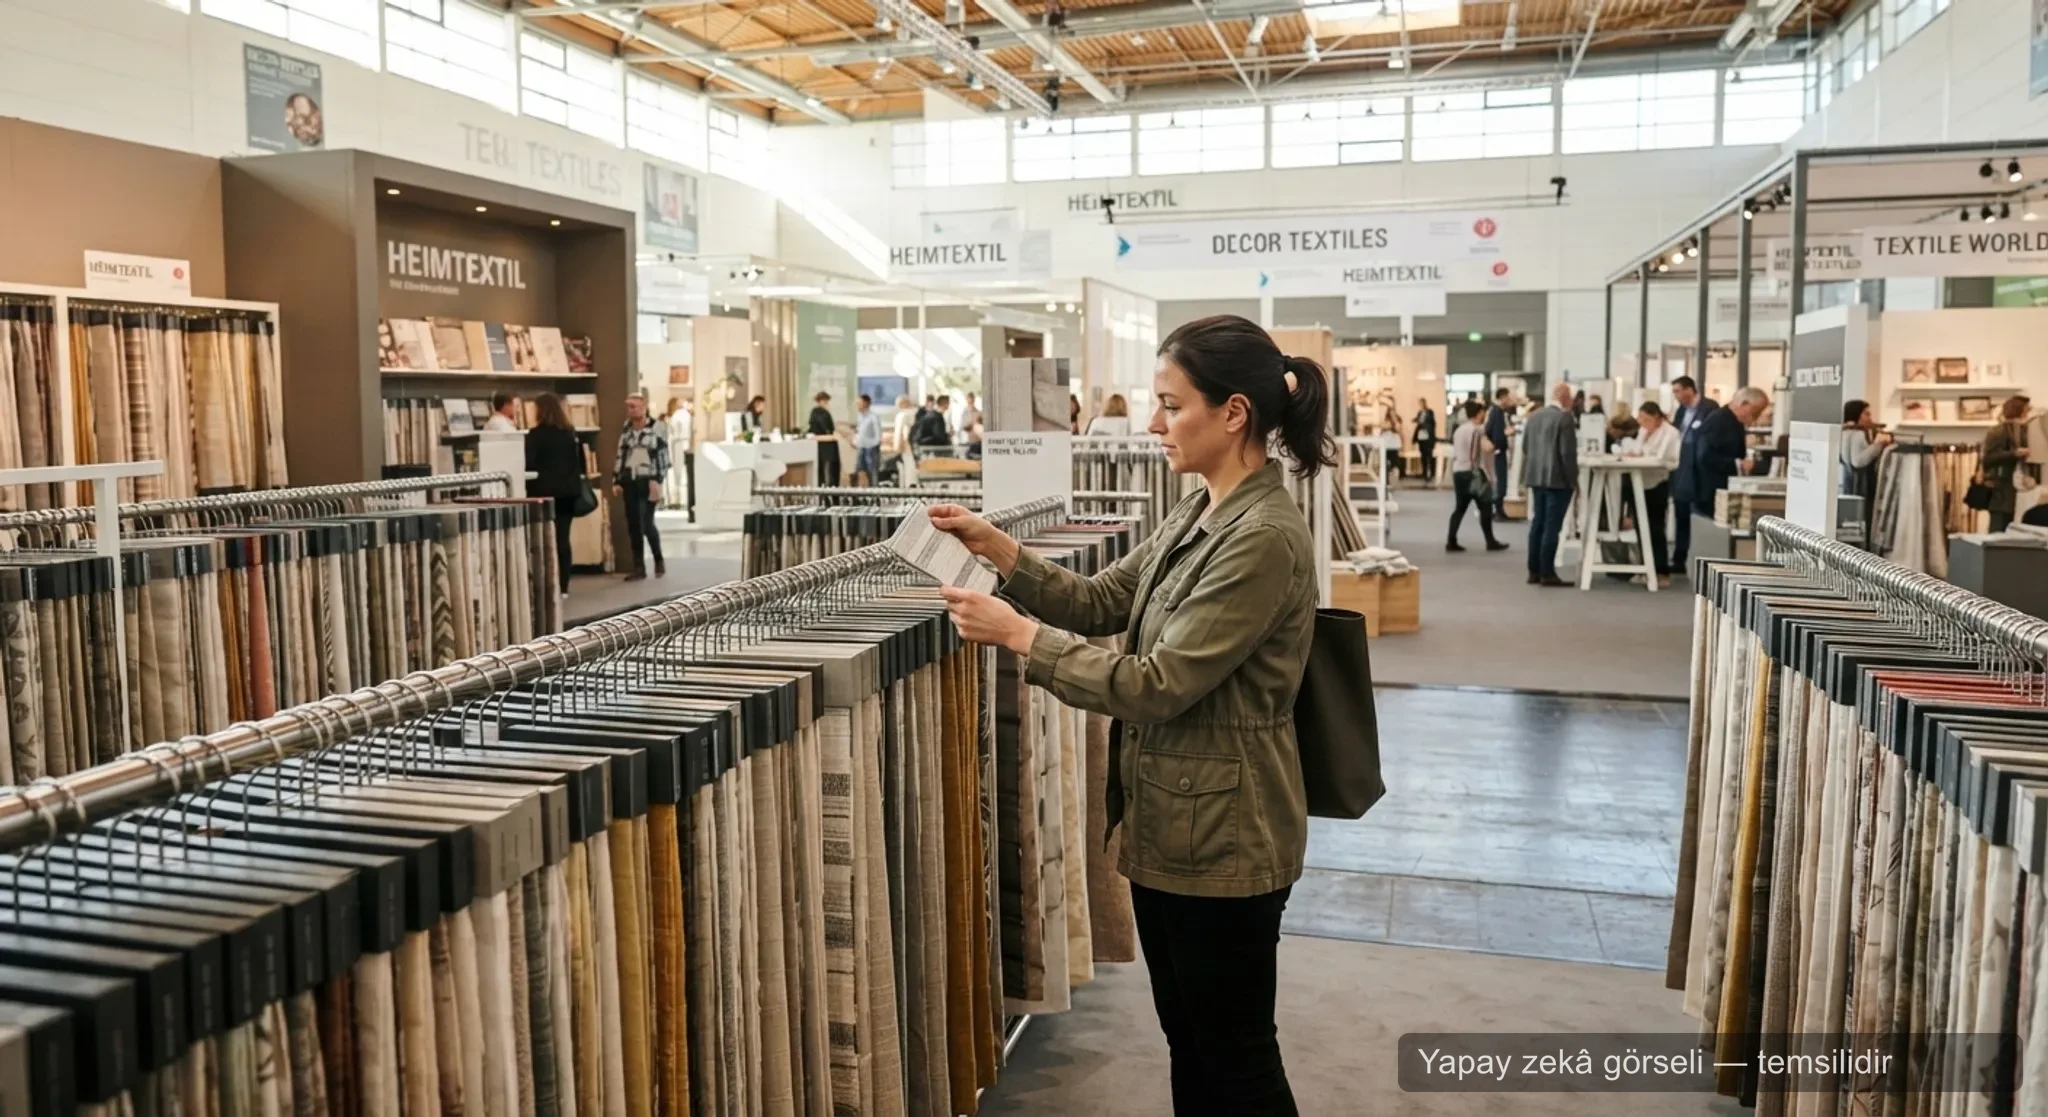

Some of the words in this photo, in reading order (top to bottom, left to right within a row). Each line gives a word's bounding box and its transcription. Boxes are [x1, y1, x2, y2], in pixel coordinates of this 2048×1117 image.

[1212, 232, 1282, 254] DECOR
[1289, 228, 1388, 251] TEXTILES
[1873, 234, 1963, 256] TEXTILE
[1968, 231, 2048, 252] WORLD
[388, 240, 527, 289] HEIMTEXTIL
[890, 243, 1007, 265] HEIMTEXTIL
